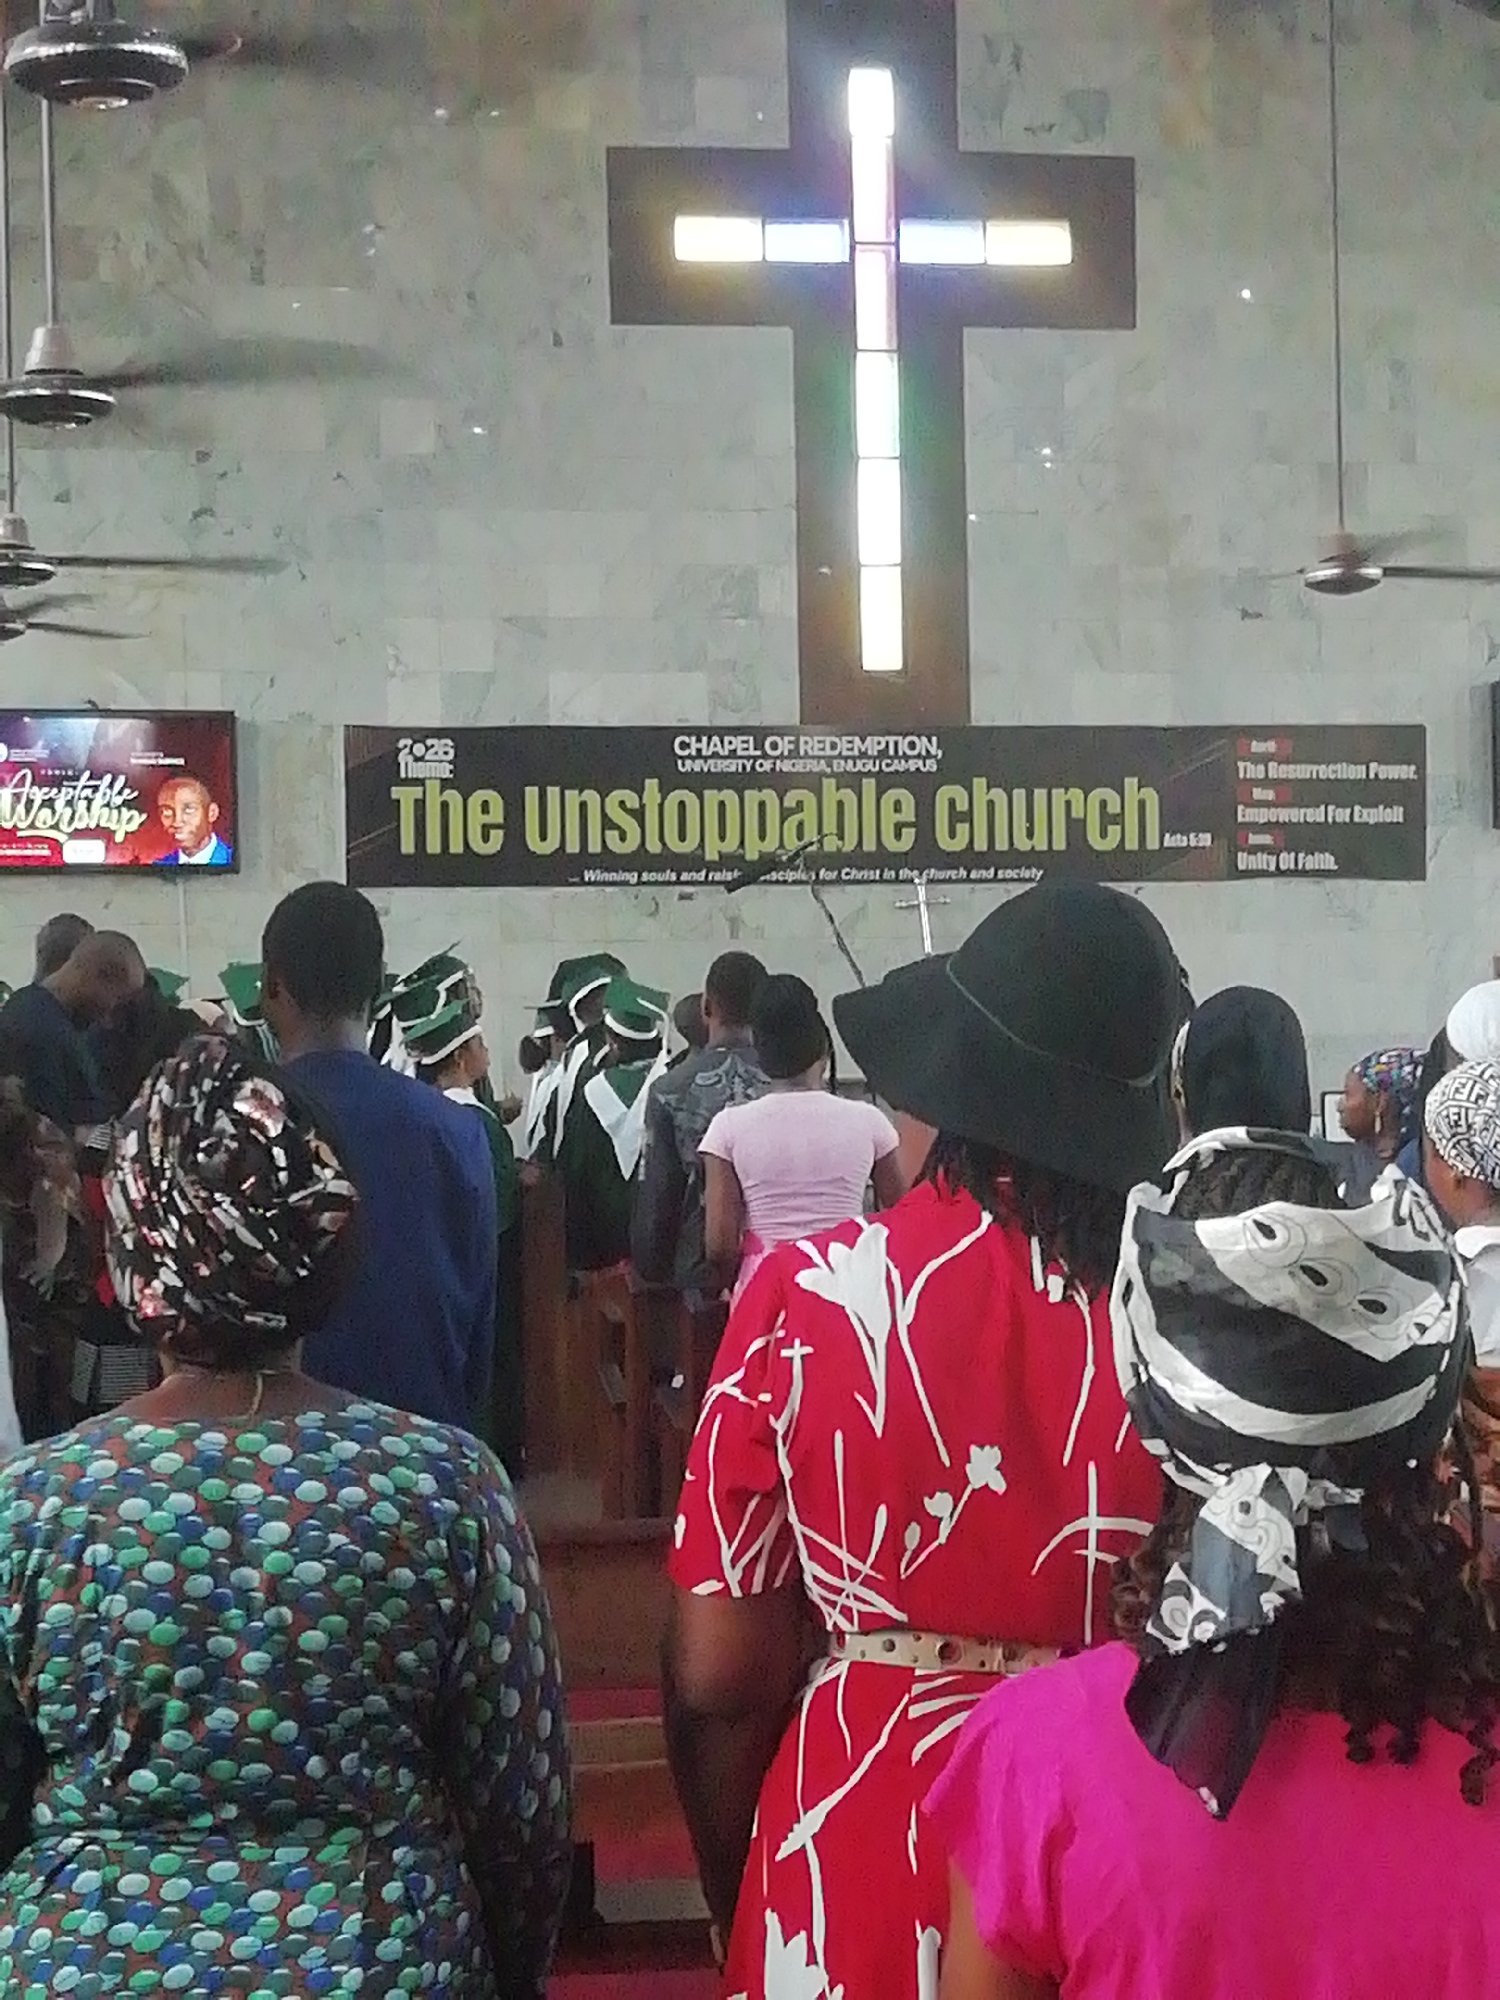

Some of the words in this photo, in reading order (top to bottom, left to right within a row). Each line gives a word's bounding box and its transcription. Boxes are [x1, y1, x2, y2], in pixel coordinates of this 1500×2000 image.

[674, 735, 762, 756] CHAPEL
[764, 735, 797, 756] OF
[799, 735, 943, 759] REDEMPTION,
[677, 759, 753, 772] UNIVERSITY
[755, 760, 775, 772] OF
[776, 759, 831, 774] NIGERIA,
[833, 759, 879, 772] ENUGU
[881, 759, 937, 772] CAMPUS
[1237, 761, 1265, 779] The
[1267, 761, 1366, 779] Resurrection
[390, 778, 505, 854] The
[524, 777, 916, 861] Unstoppable
[1237, 805, 1325, 824] Empowered
[1327, 804, 1351, 823] For
[1238, 851, 1277, 871] Unity
[584, 869, 638, 884] Winning
[641, 869, 677, 882] souls
[679, 869, 706, 882] and
[819, 868, 838, 880] for
[841, 867, 880, 880] Christ
[883, 867, 895, 880] in
[922, 866, 967, 881] church
[969, 866, 994, 879] and
[997, 866, 1044, 882] society
